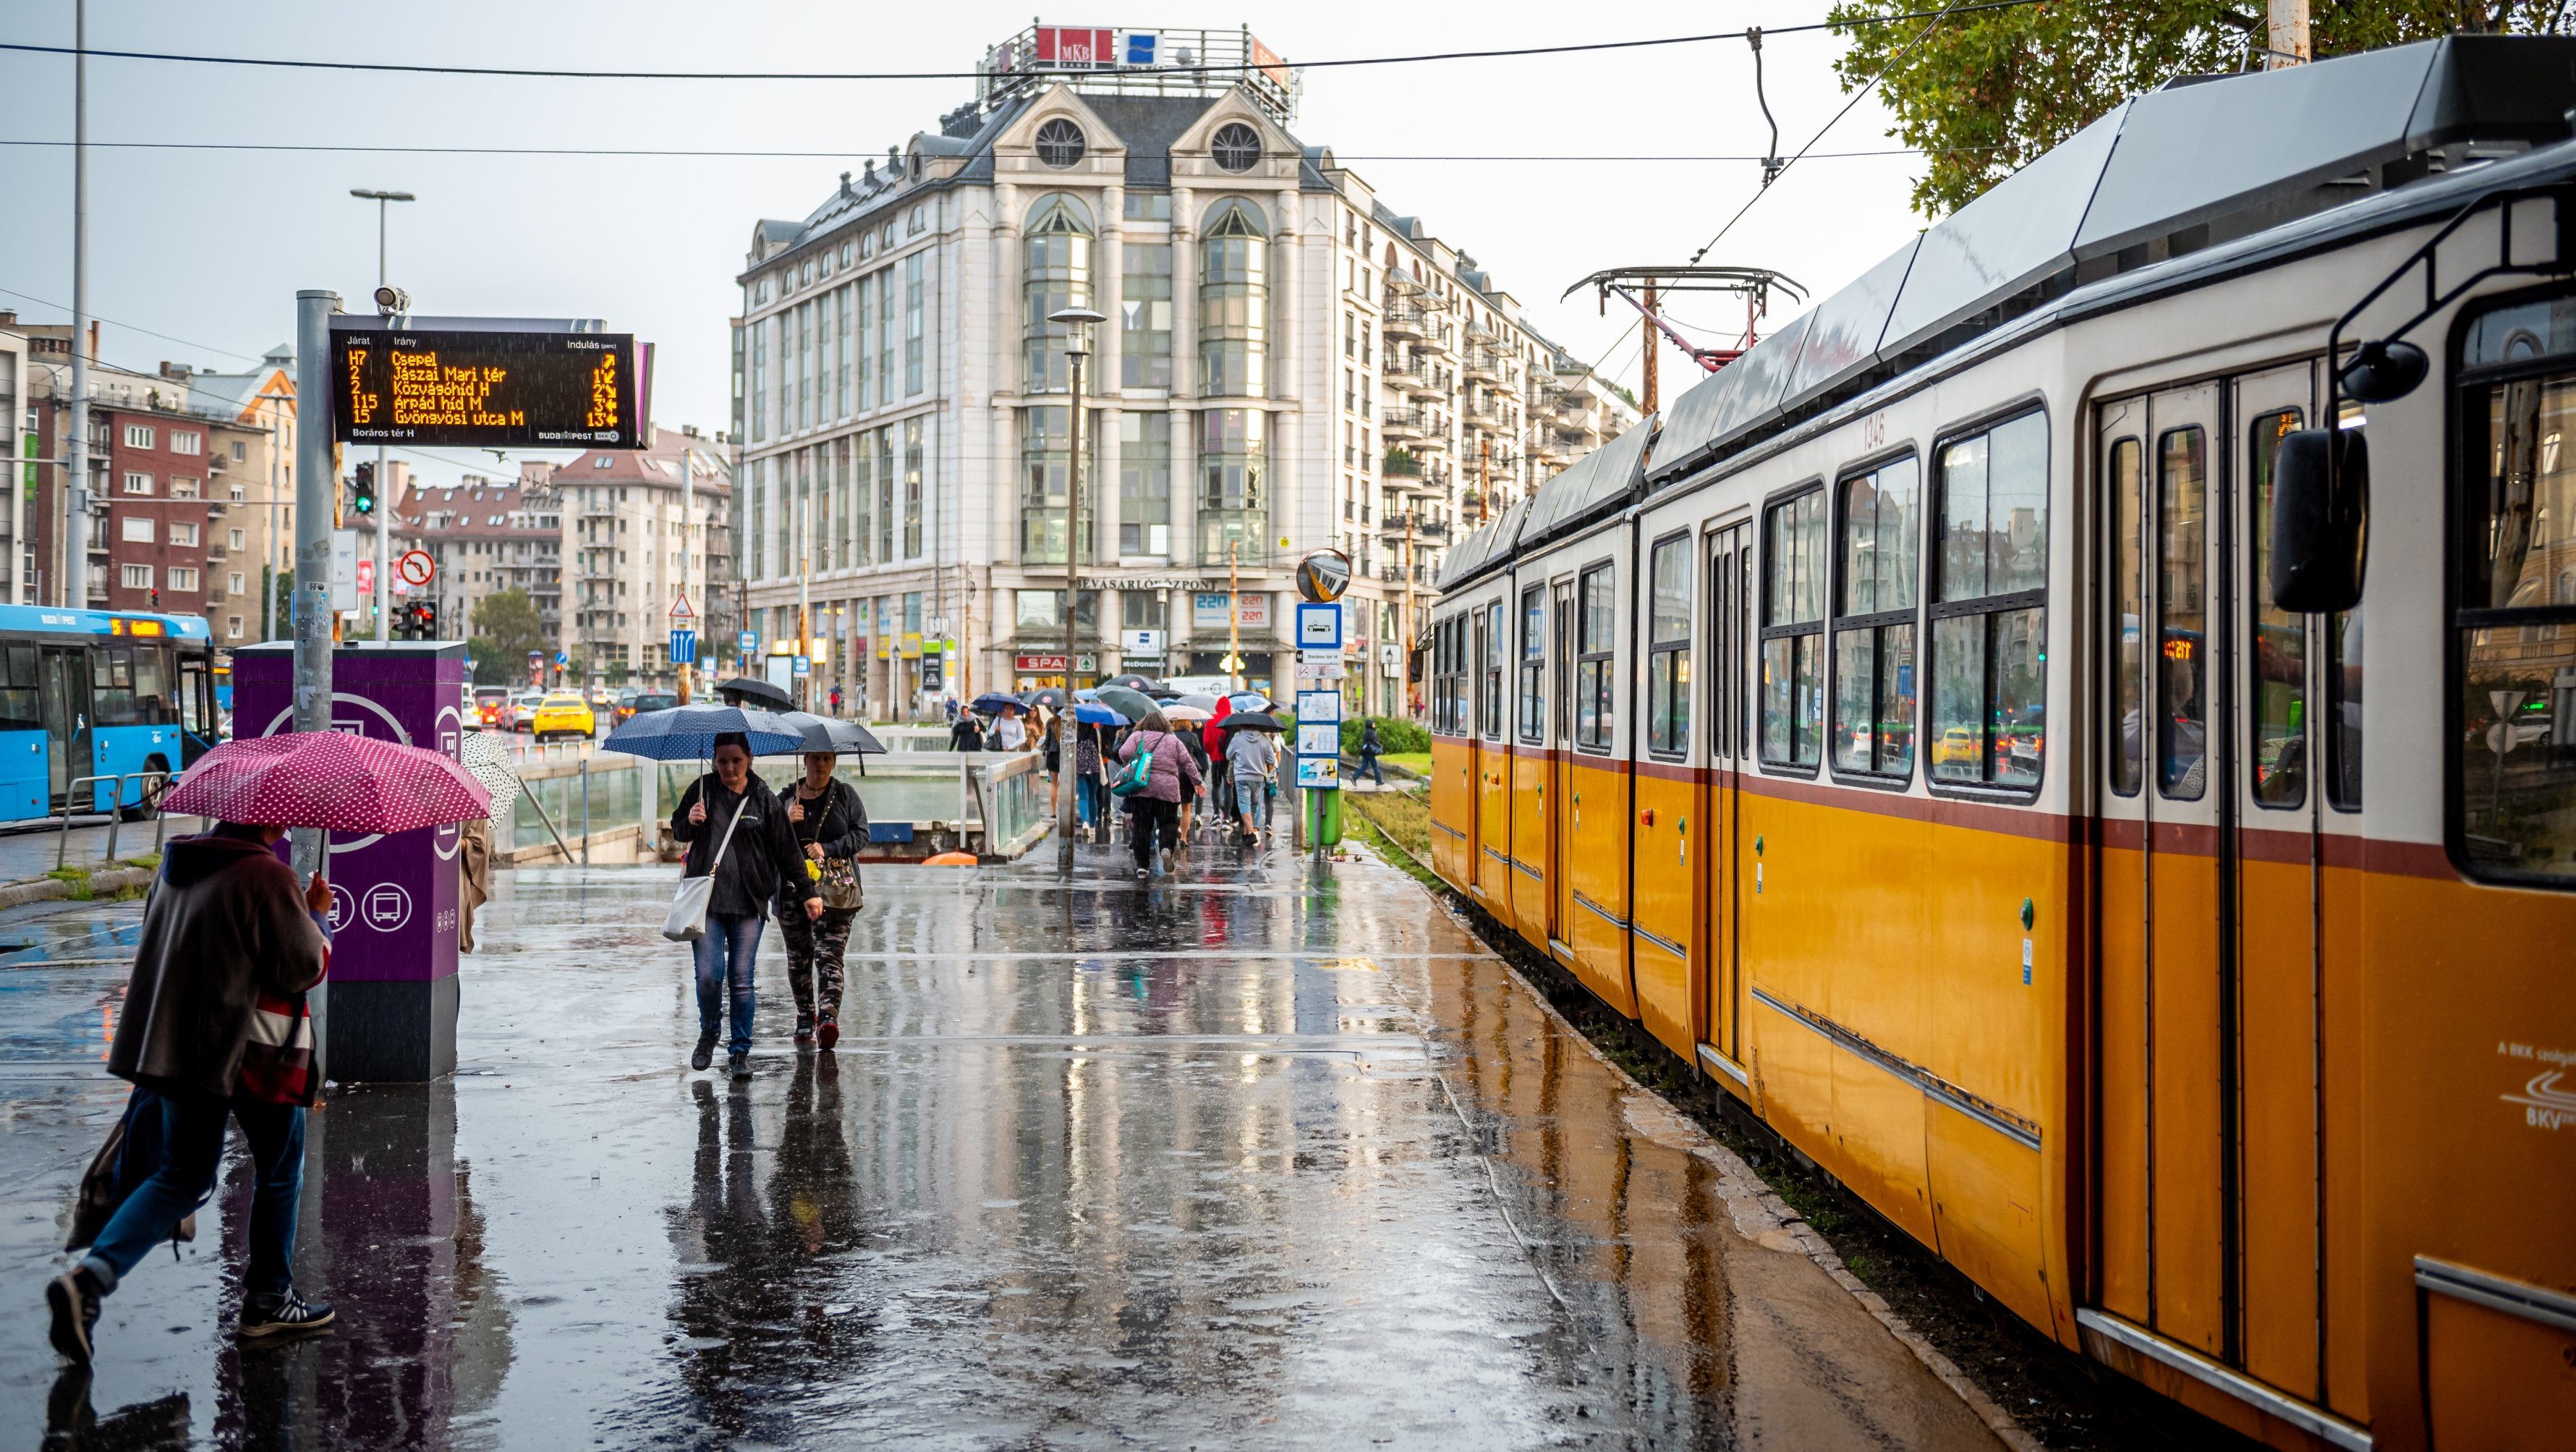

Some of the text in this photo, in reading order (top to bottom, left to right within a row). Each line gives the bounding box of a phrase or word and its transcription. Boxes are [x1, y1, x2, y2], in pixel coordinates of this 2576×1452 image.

[1062, 45, 1089, 61] MKB
[347, 336, 370, 345] Járat
[394, 337, 417, 347] Irány
[567, 340, 599, 349] Indulás
[349, 350, 437, 366] H7 Csepel
[350, 365, 360, 379] 2
[394, 367, 439, 381] Jászai
[445, 367, 477, 381] Mari
[483, 367, 506, 382] tér
[351, 381, 360, 394] 2
[394, 381, 474, 396] Közvágóhíd
[480, 382, 489, 396] H
[353, 394, 378, 408] 115
[395, 396, 435, 409] Árpád
[441, 396, 464, 409] híd
[470, 396, 482, 410] M
[354, 409, 370, 423] 15
[396, 410, 467, 425] Gyöngyösi
[474, 411, 506, 425] utca
[511, 411, 524, 425] M
[353, 428, 388, 437] Boráros
[1865, 412, 1884, 451] 1346
[2498, 1042, 2506, 1054] A
[2527, 1105, 2560, 1130] BKV
